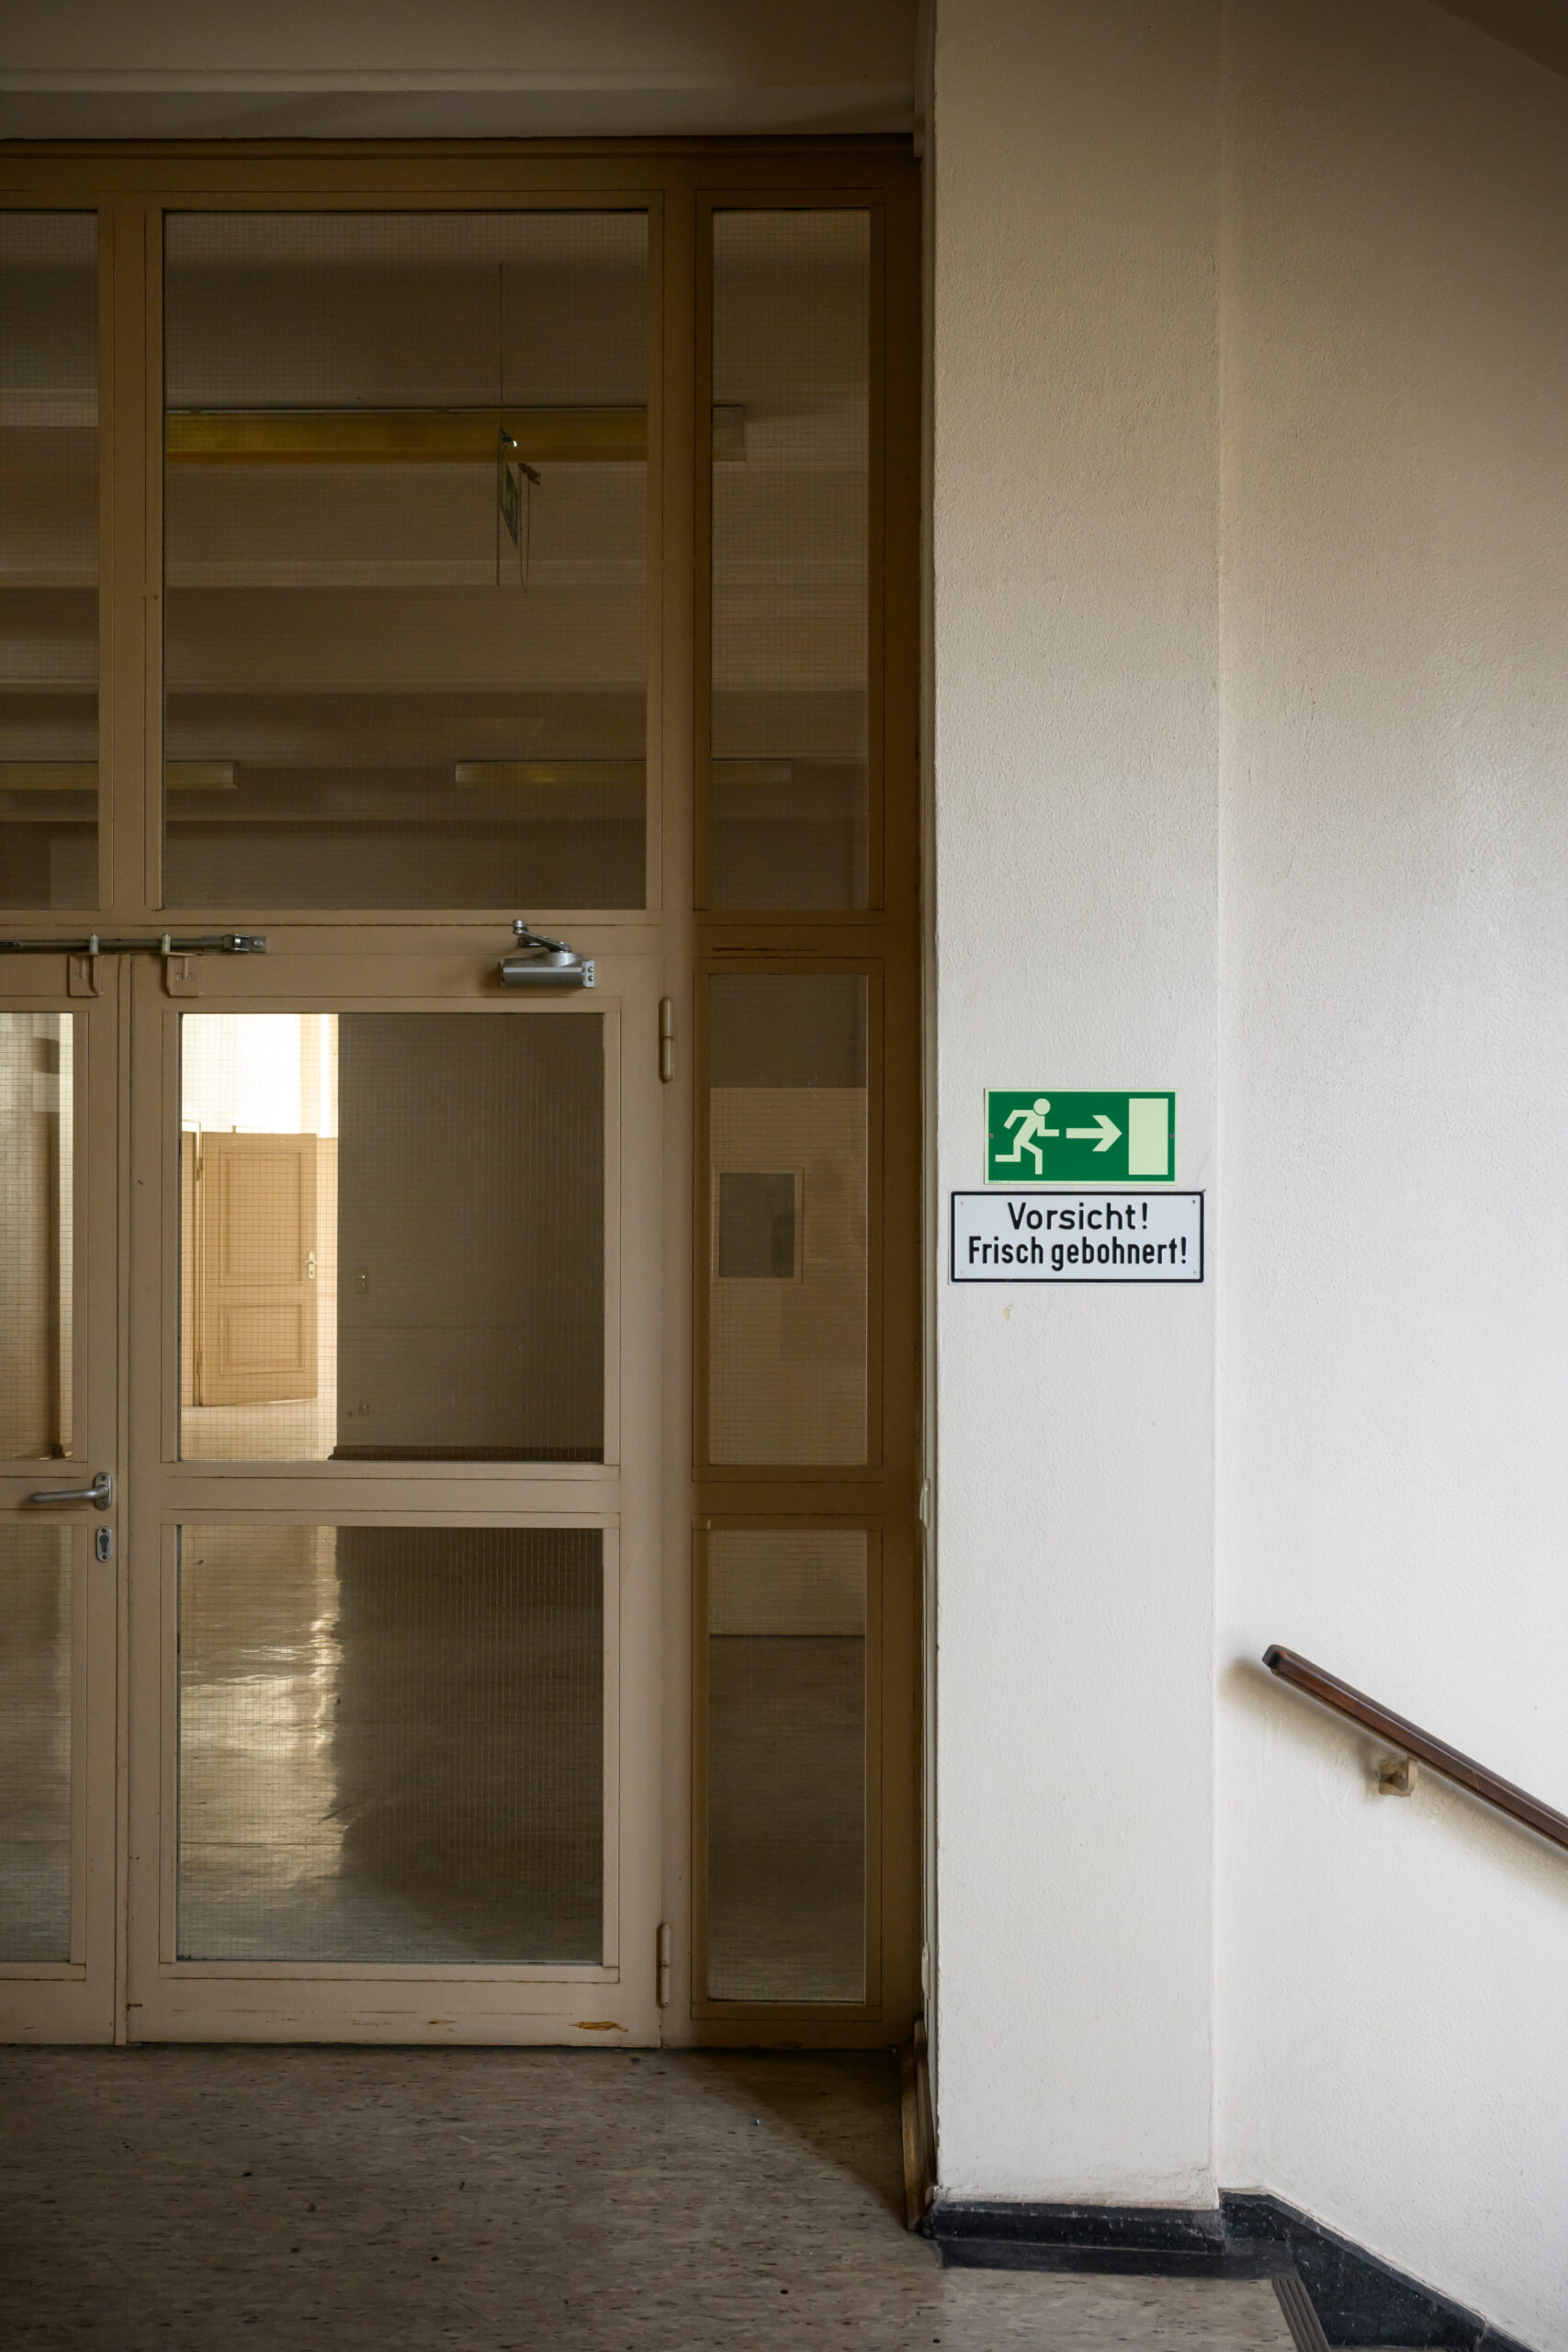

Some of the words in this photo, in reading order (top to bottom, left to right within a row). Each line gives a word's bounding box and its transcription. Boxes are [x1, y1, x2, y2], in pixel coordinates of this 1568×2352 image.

[1007, 1202, 1148, 1230] Vorsicht!
[968, 1236, 1043, 1264] Frisch
[1051, 1236, 1187, 1272] gebohnert!
